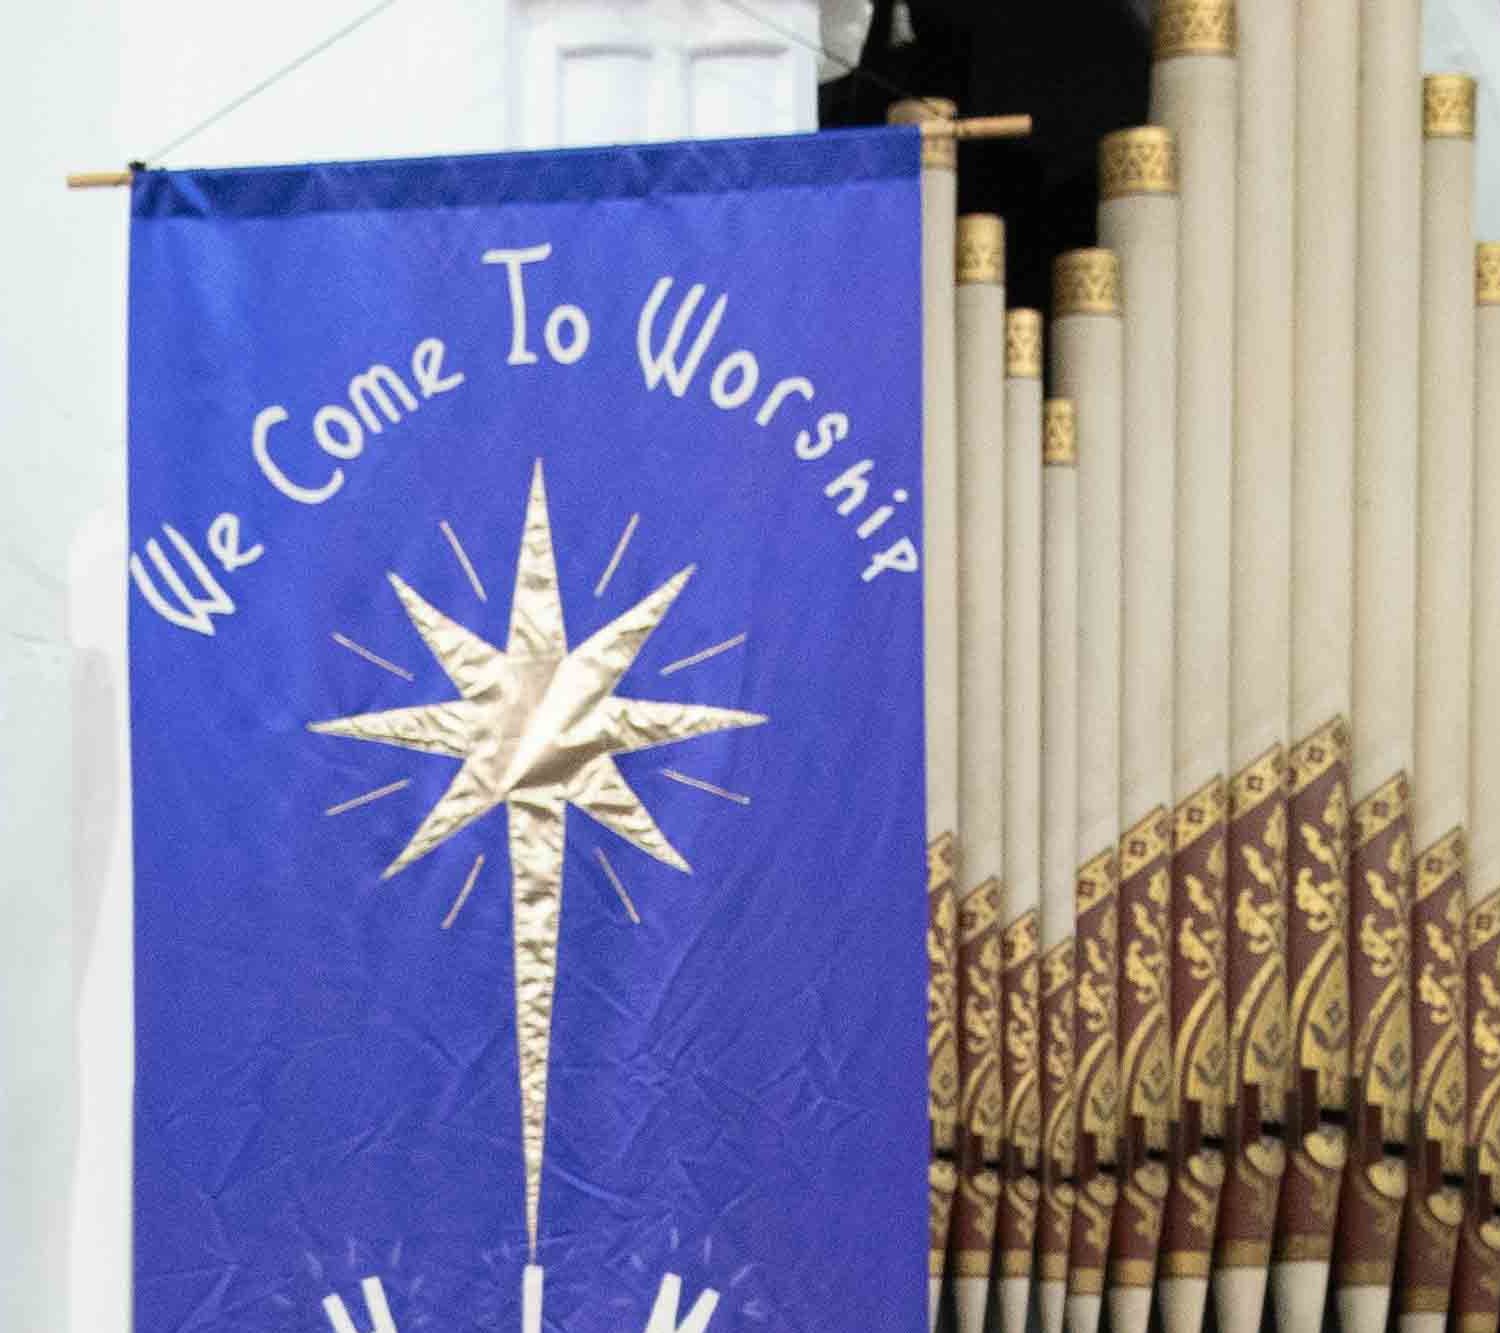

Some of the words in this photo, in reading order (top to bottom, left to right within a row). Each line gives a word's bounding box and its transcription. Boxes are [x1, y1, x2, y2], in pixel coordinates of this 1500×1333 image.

[129, 512, 265, 637] We
[252, 337, 465, 505] Come
[482, 243, 590, 365] To
[637, 276, 919, 583] Worship
